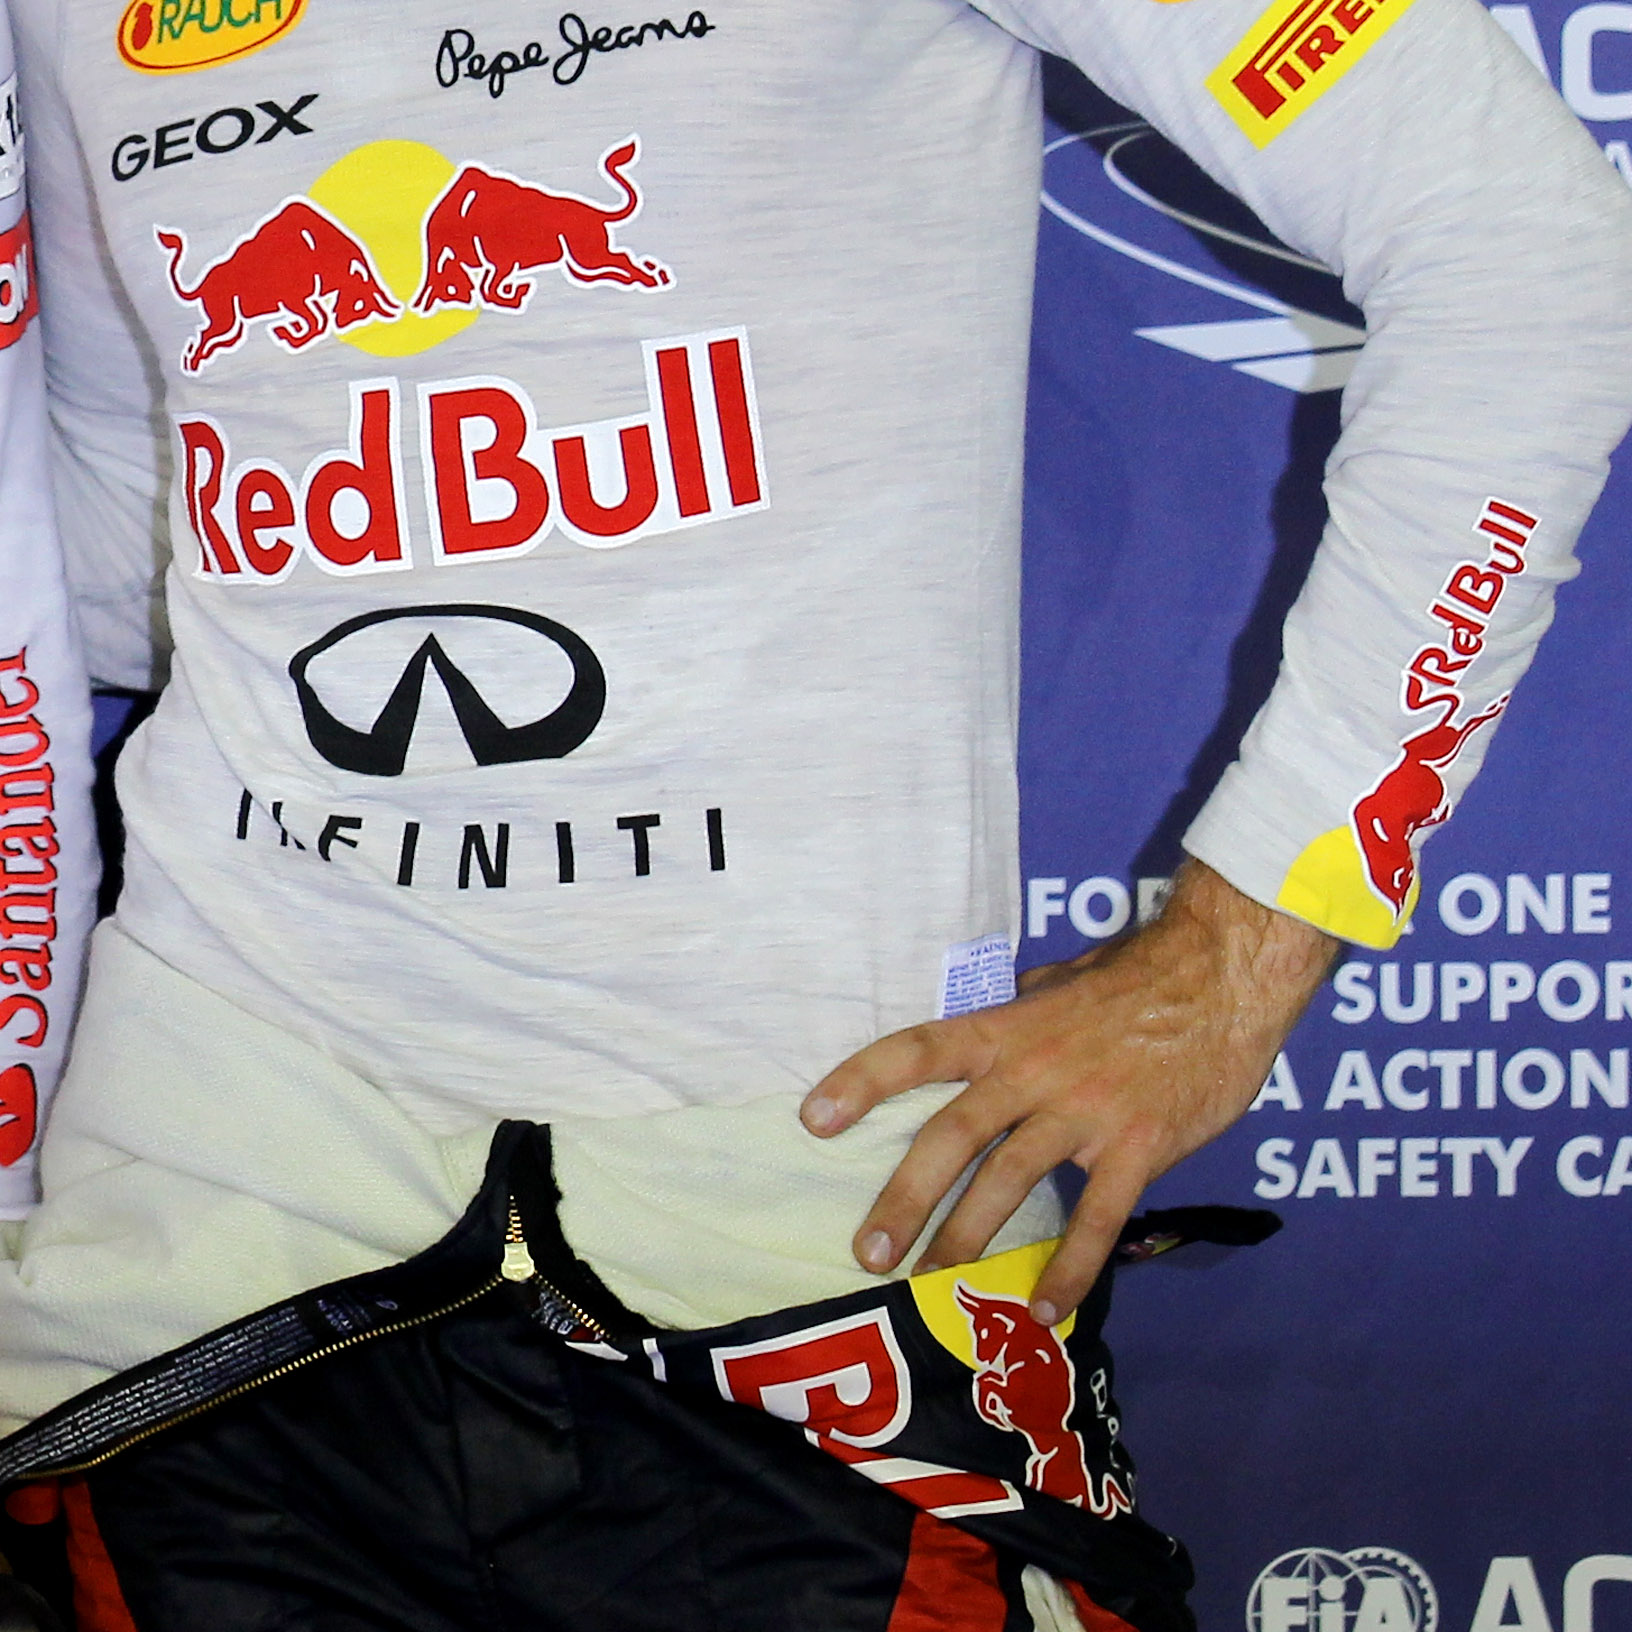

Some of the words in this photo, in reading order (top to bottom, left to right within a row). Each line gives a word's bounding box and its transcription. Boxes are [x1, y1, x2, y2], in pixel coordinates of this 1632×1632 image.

[435, 27, 550, 99] Pepe
[551, 9, 717, 87] Jeans
[111, 93, 321, 184] GEOX
[178, 387, 405, 576] Red
[427, 336, 763, 556] Bull
[1445, 500, 1539, 615] Bull
[1409, 601, 1487, 687] Red
[1437, 872, 1612, 936] ONE
[1323, 1048, 1630, 1112] ACTION
[1253, 1136, 1534, 1199] SAFETY
